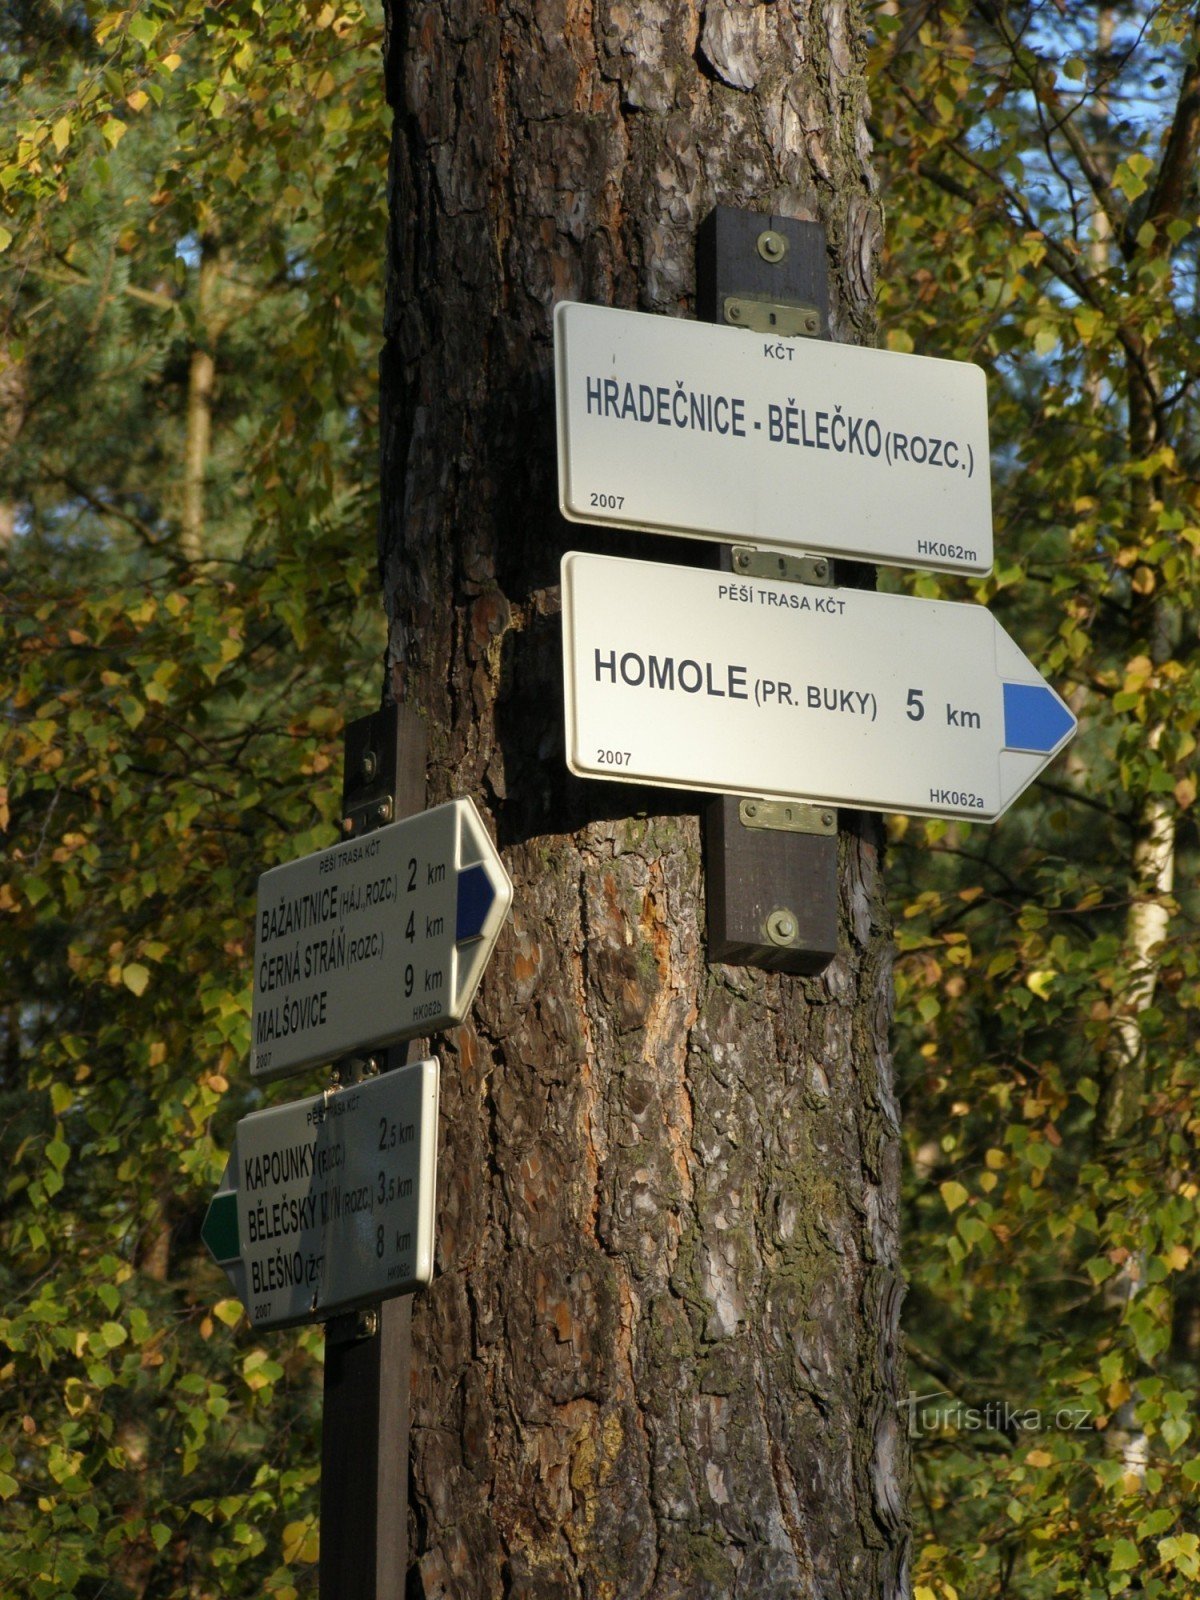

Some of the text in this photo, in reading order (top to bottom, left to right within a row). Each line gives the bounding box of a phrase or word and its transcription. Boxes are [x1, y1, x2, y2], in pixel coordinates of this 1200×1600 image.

[764, 343, 795, 361] KČT
[586, 376, 746, 437] HRADEČNICE
[590, 493, 625, 511] 2007
[918, 540, 978, 562] HK062m
[718, 584, 846, 615] PĚŠÍ TRASA KČT
[594, 648, 982, 729] HOMOLE (PR. BUKY) 5 km
[597, 749, 632, 767] 2007
[929, 788, 985, 809] HK062a
[338, 846, 364, 869] TRASA
[365, 839, 381, 857] KČT
[407, 858, 417, 892] 2
[427, 861, 446, 887] km
[259, 941, 301, 994] ČERNÁ
[405, 910, 416, 944] 4
[425, 915, 444, 939] km
[256, 964, 443, 1045] MALŠOVICE 9 km
[256, 1052, 272, 1069] 2007
[379, 1117, 396, 1151] 2,5
[399, 1125, 415, 1147] km
[248, 1187, 317, 1243] BĚLEČSKÝ
[377, 1171, 395, 1207] 3,5
[397, 1177, 413, 1199] km
[376, 1224, 385, 1259] 8
[396, 1230, 411, 1252] km
[255, 1302, 272, 1320] 2007
